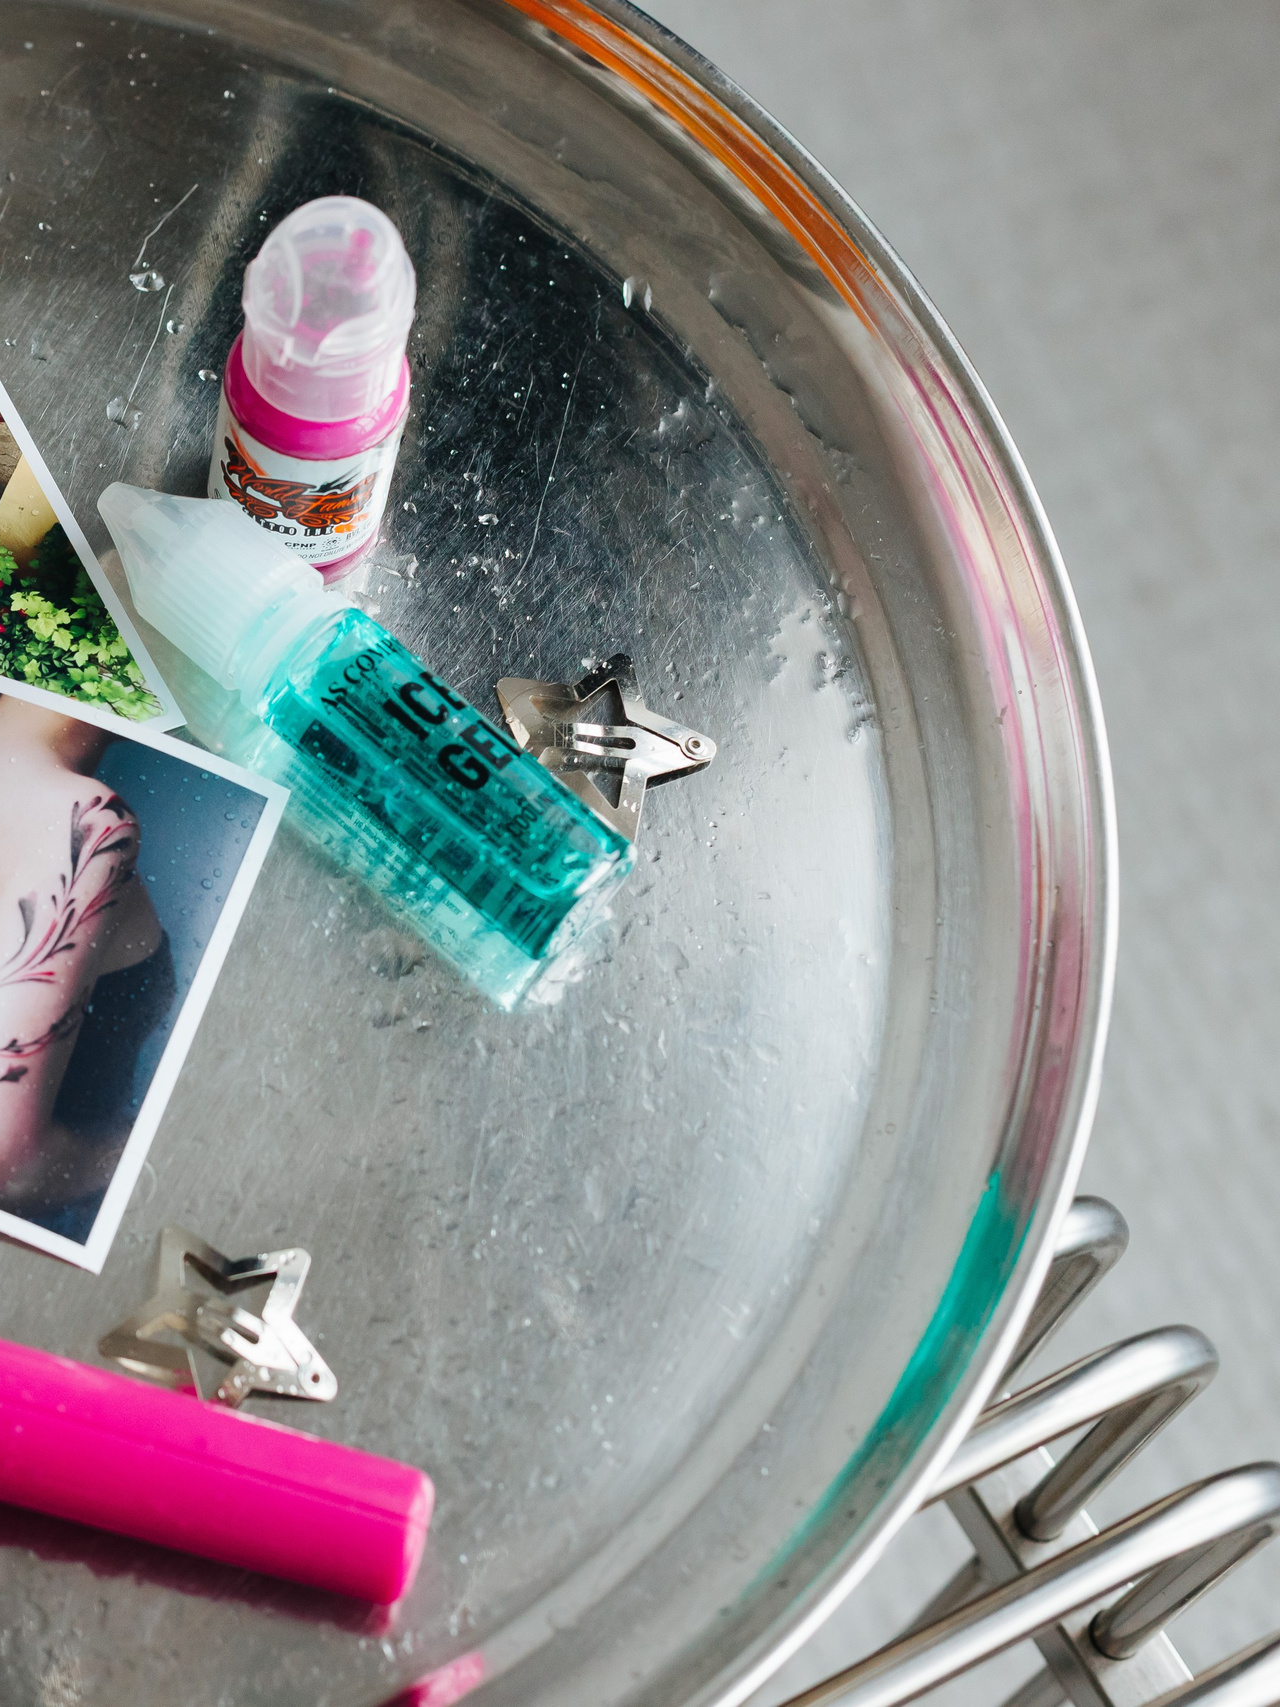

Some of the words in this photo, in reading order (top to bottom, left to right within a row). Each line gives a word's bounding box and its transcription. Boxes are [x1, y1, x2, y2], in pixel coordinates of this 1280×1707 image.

[304, 526, 334, 536] INK
[320, 681, 348, 715] AS
[383, 671, 467, 741] ICE
